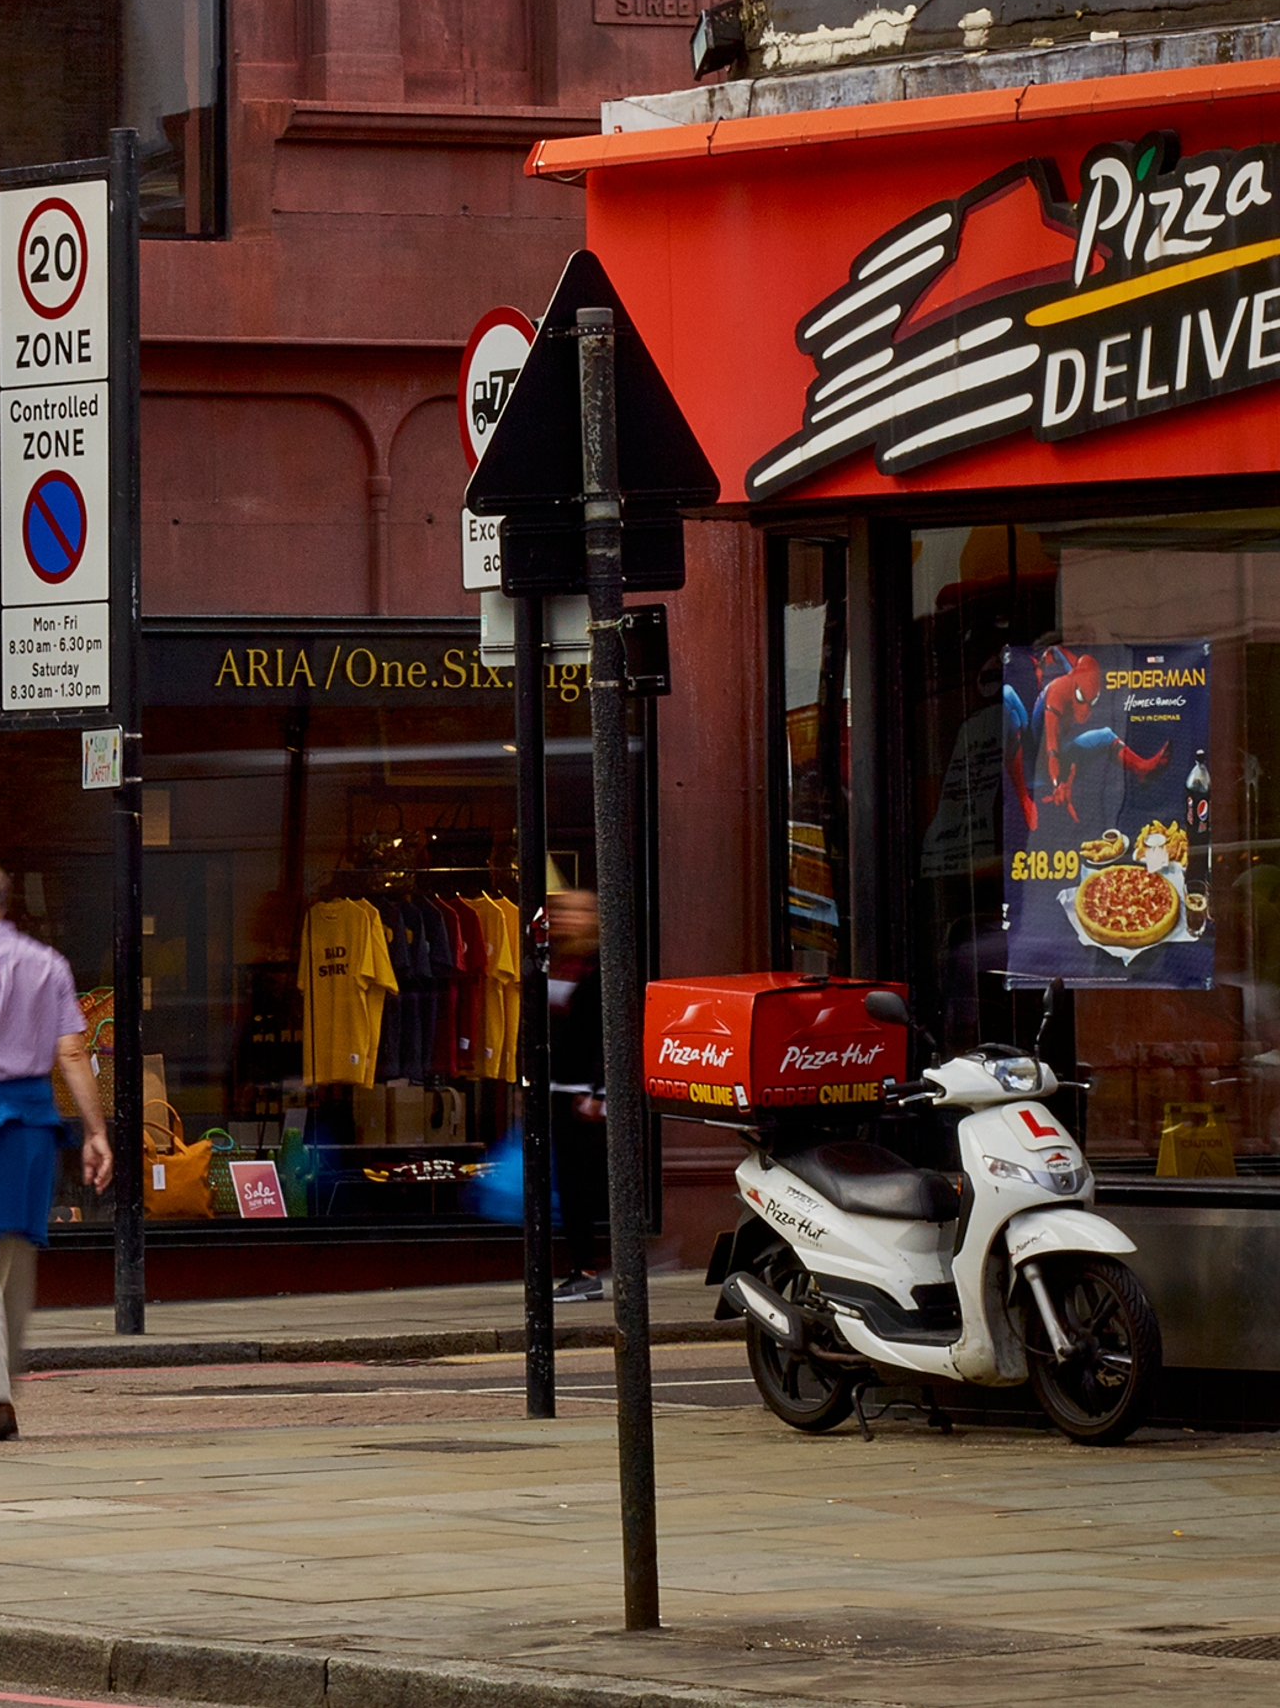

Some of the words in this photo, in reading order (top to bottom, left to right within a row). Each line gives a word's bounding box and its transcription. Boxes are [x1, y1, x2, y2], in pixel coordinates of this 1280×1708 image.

[1074, 148, 1272, 289] Pizza
[28, 232, 77, 284] 20
[15, 329, 92, 369] ZONE
[1042, 287, 1280, 428] DELIVE
[10, 393, 99, 424] Controlled
[22, 428, 85, 461] ZONE
[33, 616, 56, 632] Mon
[63, 615, 78, 630] Fri
[9, 639, 34, 655] 8.30
[36, 642, 51, 653] am
[59, 636, 84, 652] 6.30
[86, 639, 102, 653] pm
[31, 660, 80, 679] Saturday
[214, 647, 317, 688] ARIA
[10, 684, 35, 700] 8.30
[37, 687, 53, 698] am
[60, 681, 83, 697] 1.30
[85, 684, 102, 698] pm
[1010, 849, 1080, 881] £18.99
[658, 1037, 700, 1066] Pizza
[701, 1042, 734, 1068] Hut
[779, 1045, 838, 1073] Pizza
[839, 1043, 885, 1067] Hut
[647, 1077, 689, 1101] ORDER
[689, 1082, 735, 1107] ONLINE
[761, 1086, 818, 1108] ORDER
[819, 1082, 880, 1105] ONLINE
[1018, 1109, 1060, 1139] L
[243, 1181, 276, 1200] Sale
[765, 1197, 797, 1226] Pizza
[796, 1217, 830, 1241] Hut
